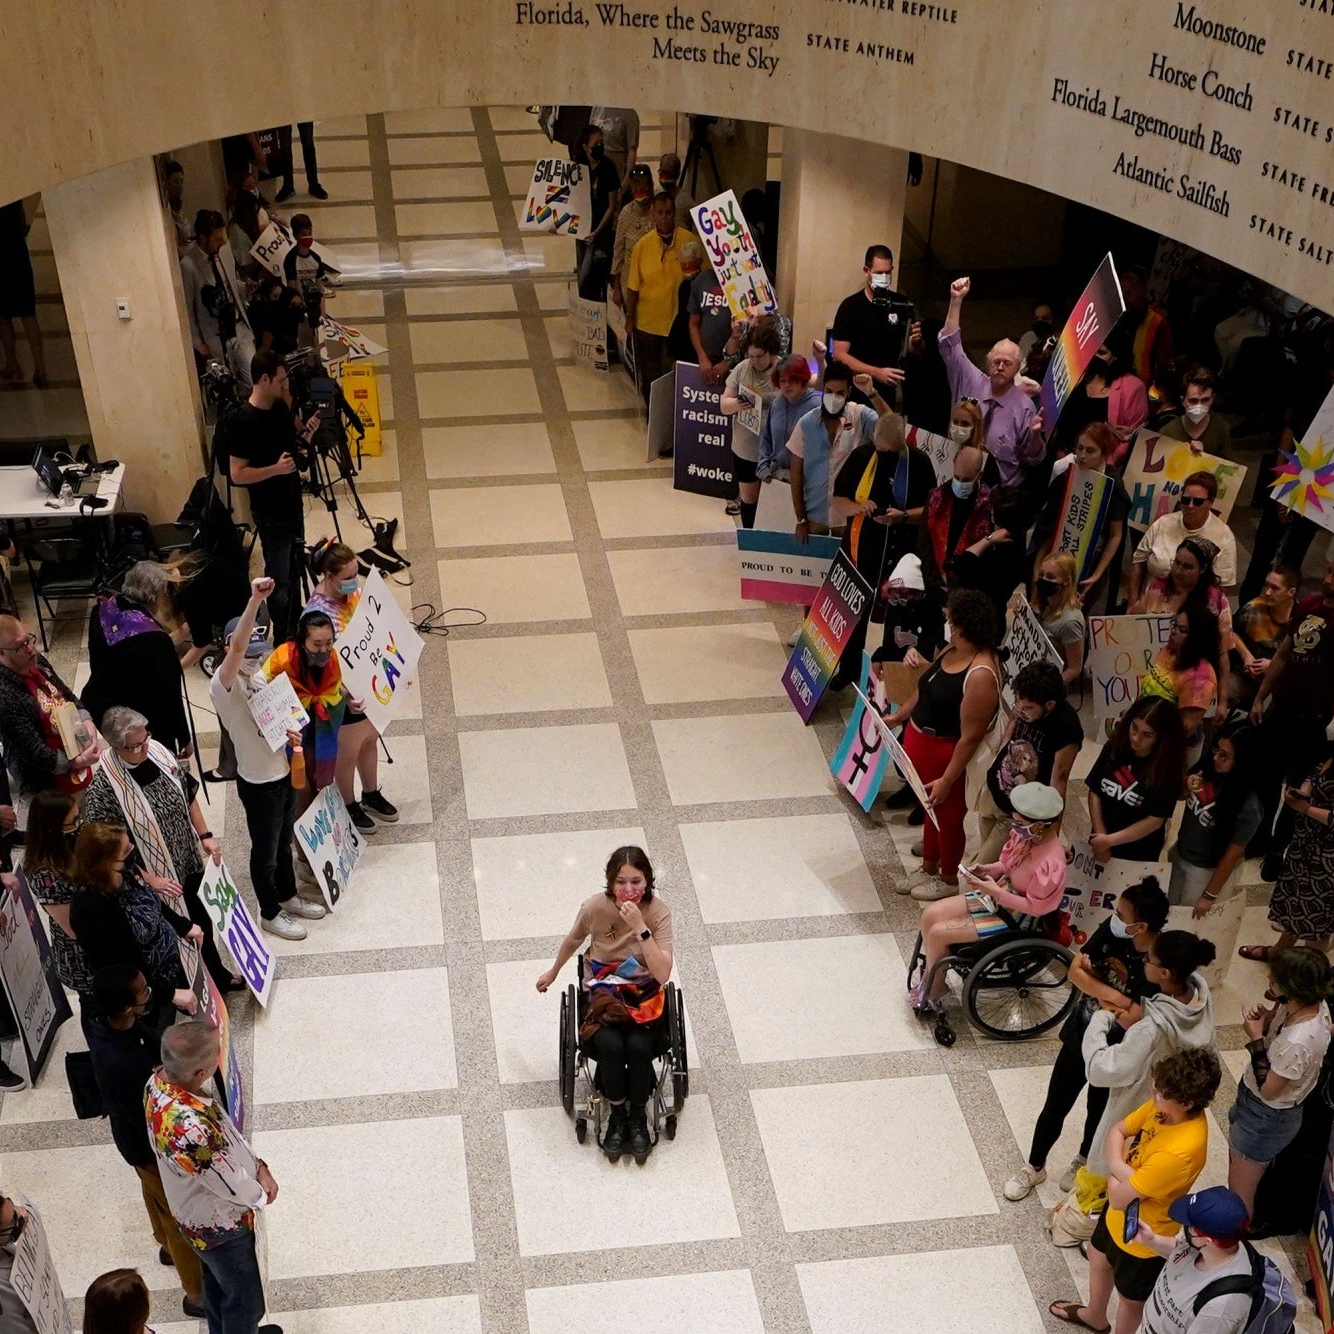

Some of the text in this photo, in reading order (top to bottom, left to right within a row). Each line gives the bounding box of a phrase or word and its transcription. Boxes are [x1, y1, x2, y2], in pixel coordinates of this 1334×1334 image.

[515, 1, 780, 45] Florida, Where the Sawgrass
[1173, 2, 1267, 55] Moonstone
[652, 37, 780, 78] Meets the Sky
[1148, 52, 1253, 112] Horse Conch
[534, 159, 583, 186] SILENCE
[1112, 151, 1230, 218] Atlantic Sailfish
[1261, 161, 1306, 193] STATE
[526, 197, 581, 234] LOVE
[698, 200, 742, 235] Gay
[706, 224, 755, 266] Youth
[719, 259, 742, 285] just
[1075, 302, 1099, 350] SAY
[682, 407, 729, 427] racism
[698, 431, 725, 447] real
[687, 463, 733, 484] #woke
[1076, 480, 1094, 532] STRIPES
[741, 562, 774, 573] PROUD
[779, 565, 794, 575] TO
[800, 568, 813, 578] BE
[830, 563, 865, 615] GOD LOVES
[819, 598, 832, 621] ALL
[340, 595, 381, 669] Proud 2
[370, 648, 382, 666] Be
[372, 631, 405, 705] GAY
[203, 865, 238, 932] Say
[228, 894, 270, 993] GAY
